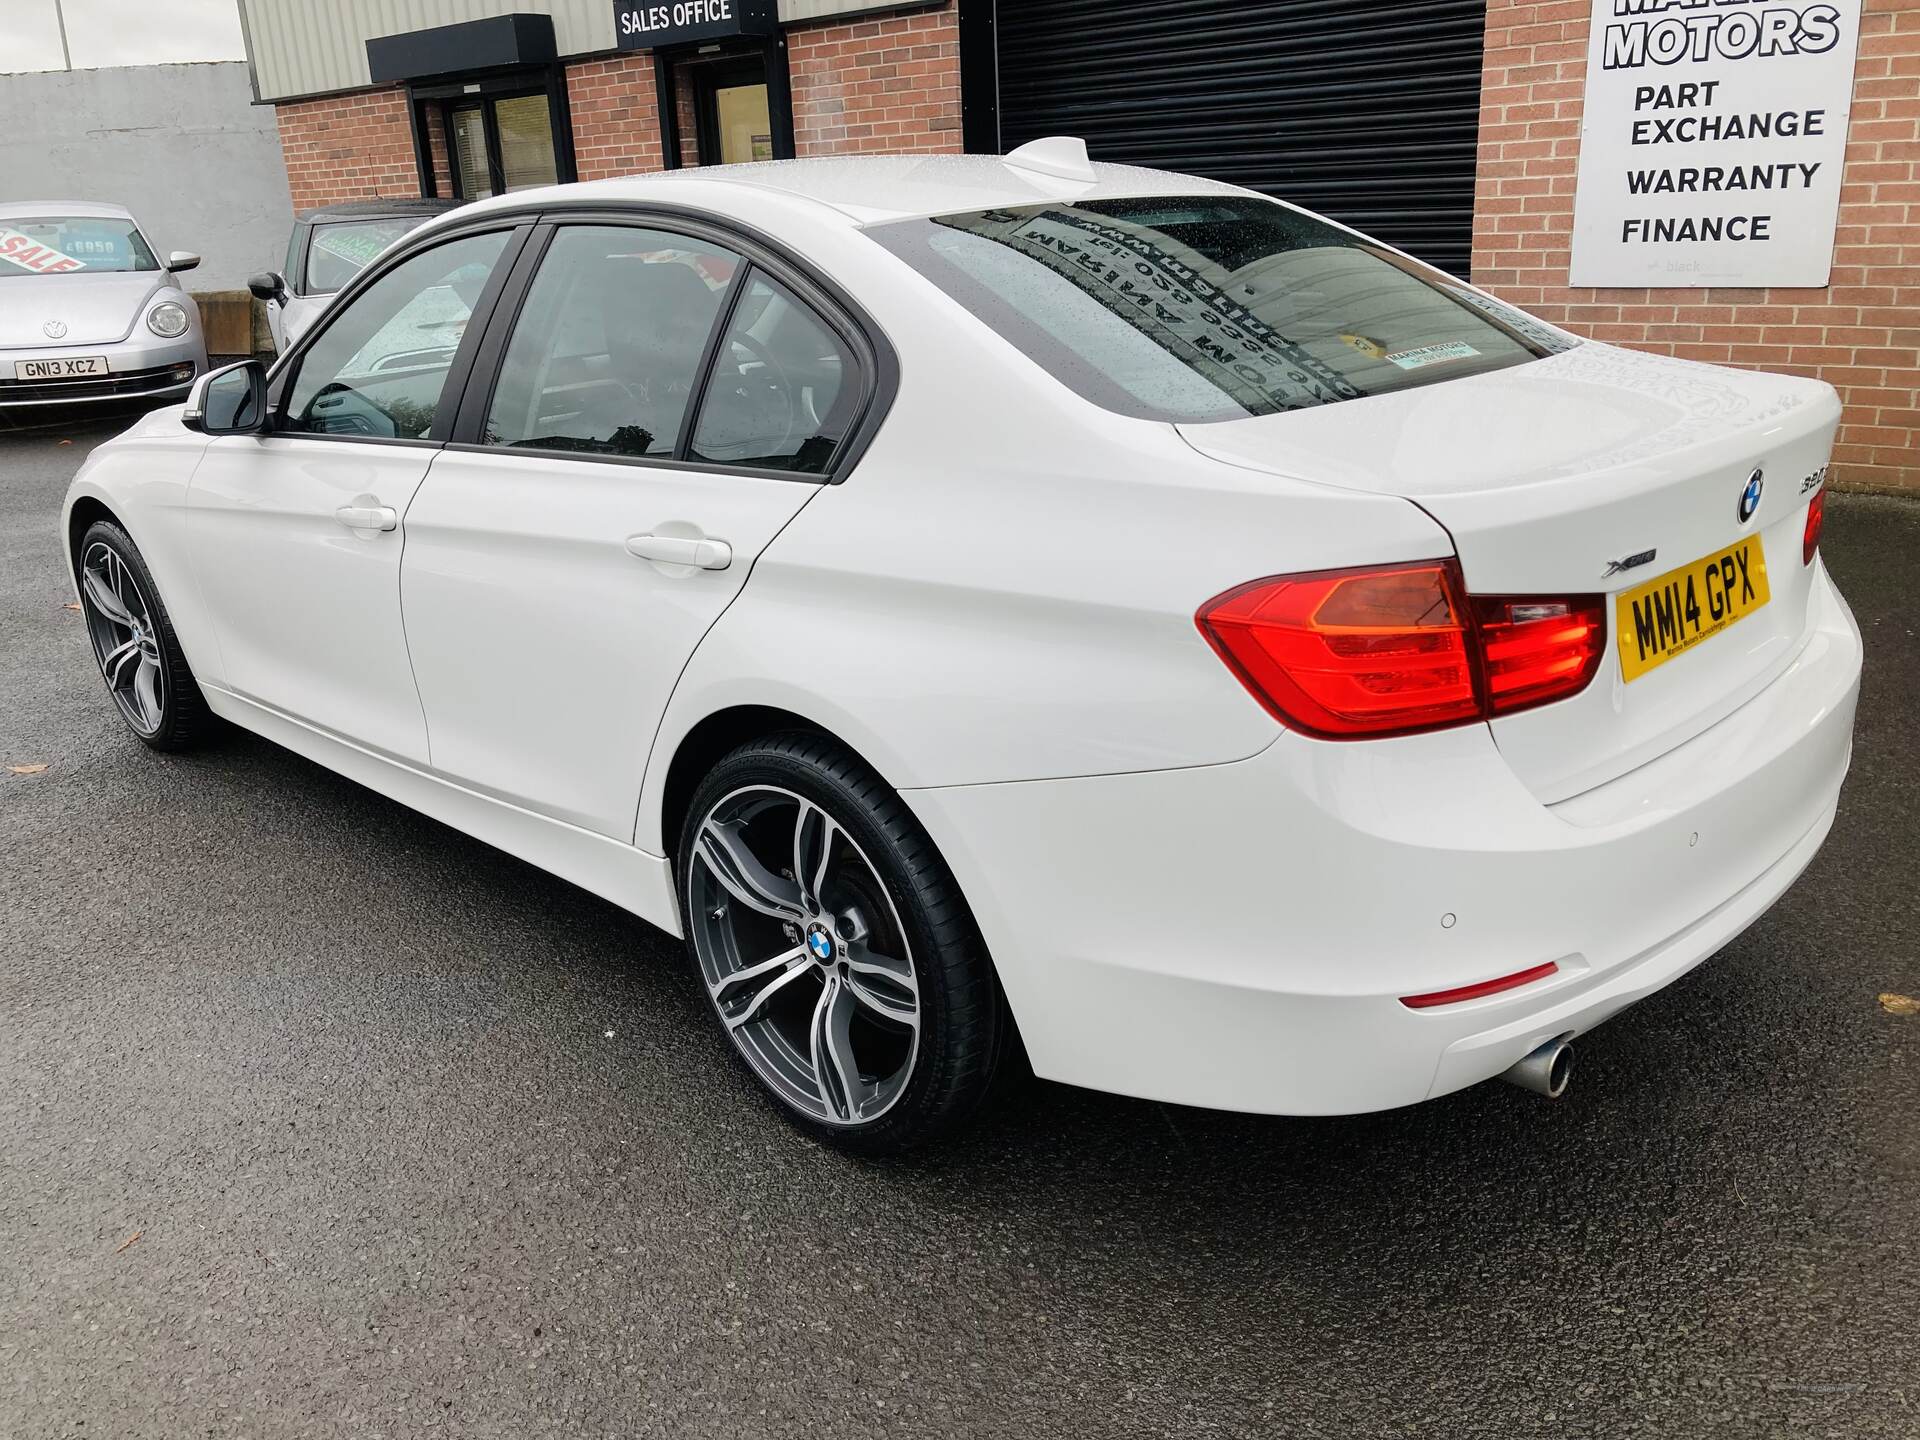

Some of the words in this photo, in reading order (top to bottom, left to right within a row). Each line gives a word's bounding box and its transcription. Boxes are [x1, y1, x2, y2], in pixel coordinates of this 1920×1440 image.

[621, 6, 670, 35] SALES
[673, 0, 732, 26] OFFICE
[1603, 4, 1841, 70] MOTORS
[1634, 81, 1720, 111] PART
[1631, 109, 1826, 146] EXCHANGE
[1626, 162, 1822, 195] WARRANTY
[1622, 215, 1771, 243] FINANCE
[25, 361, 62, 377] GN13
[65, 359, 98, 375] XCZ
[1631, 574, 1702, 662] MM14
[1704, 545, 1756, 622] GPX
